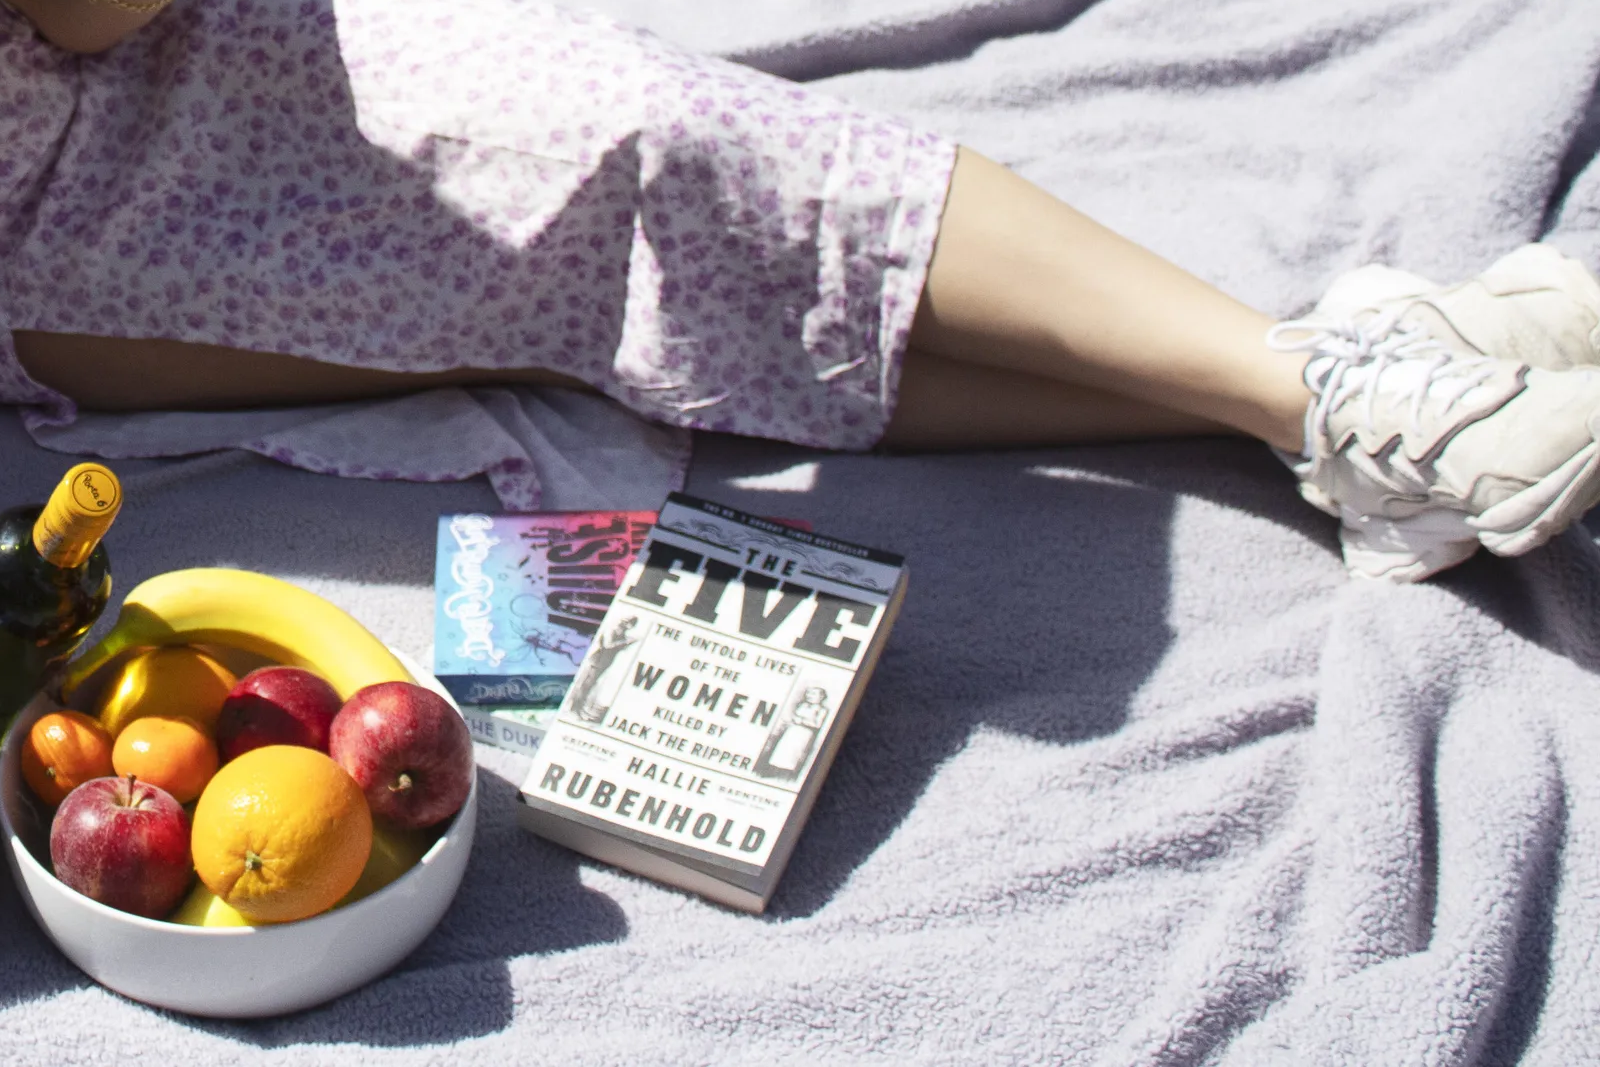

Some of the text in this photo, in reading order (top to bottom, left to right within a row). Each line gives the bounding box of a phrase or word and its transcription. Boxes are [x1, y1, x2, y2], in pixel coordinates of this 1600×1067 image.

[745, 547, 798, 577] THE
[626, 540, 878, 662] FIVE
[655, 623, 796, 676] THE UNTOLD LIVES
[690, 659, 741, 683] OF THE
[633, 661, 777, 727] WOMEN
[465, 717, 540, 749] HE DUK
[608, 715, 752, 771] JACK THE RIPPER
[653, 705, 728, 738] KILLED BY
[626, 756, 712, 796] HALLIE
[539, 762, 766, 854] RUBENHOLD
